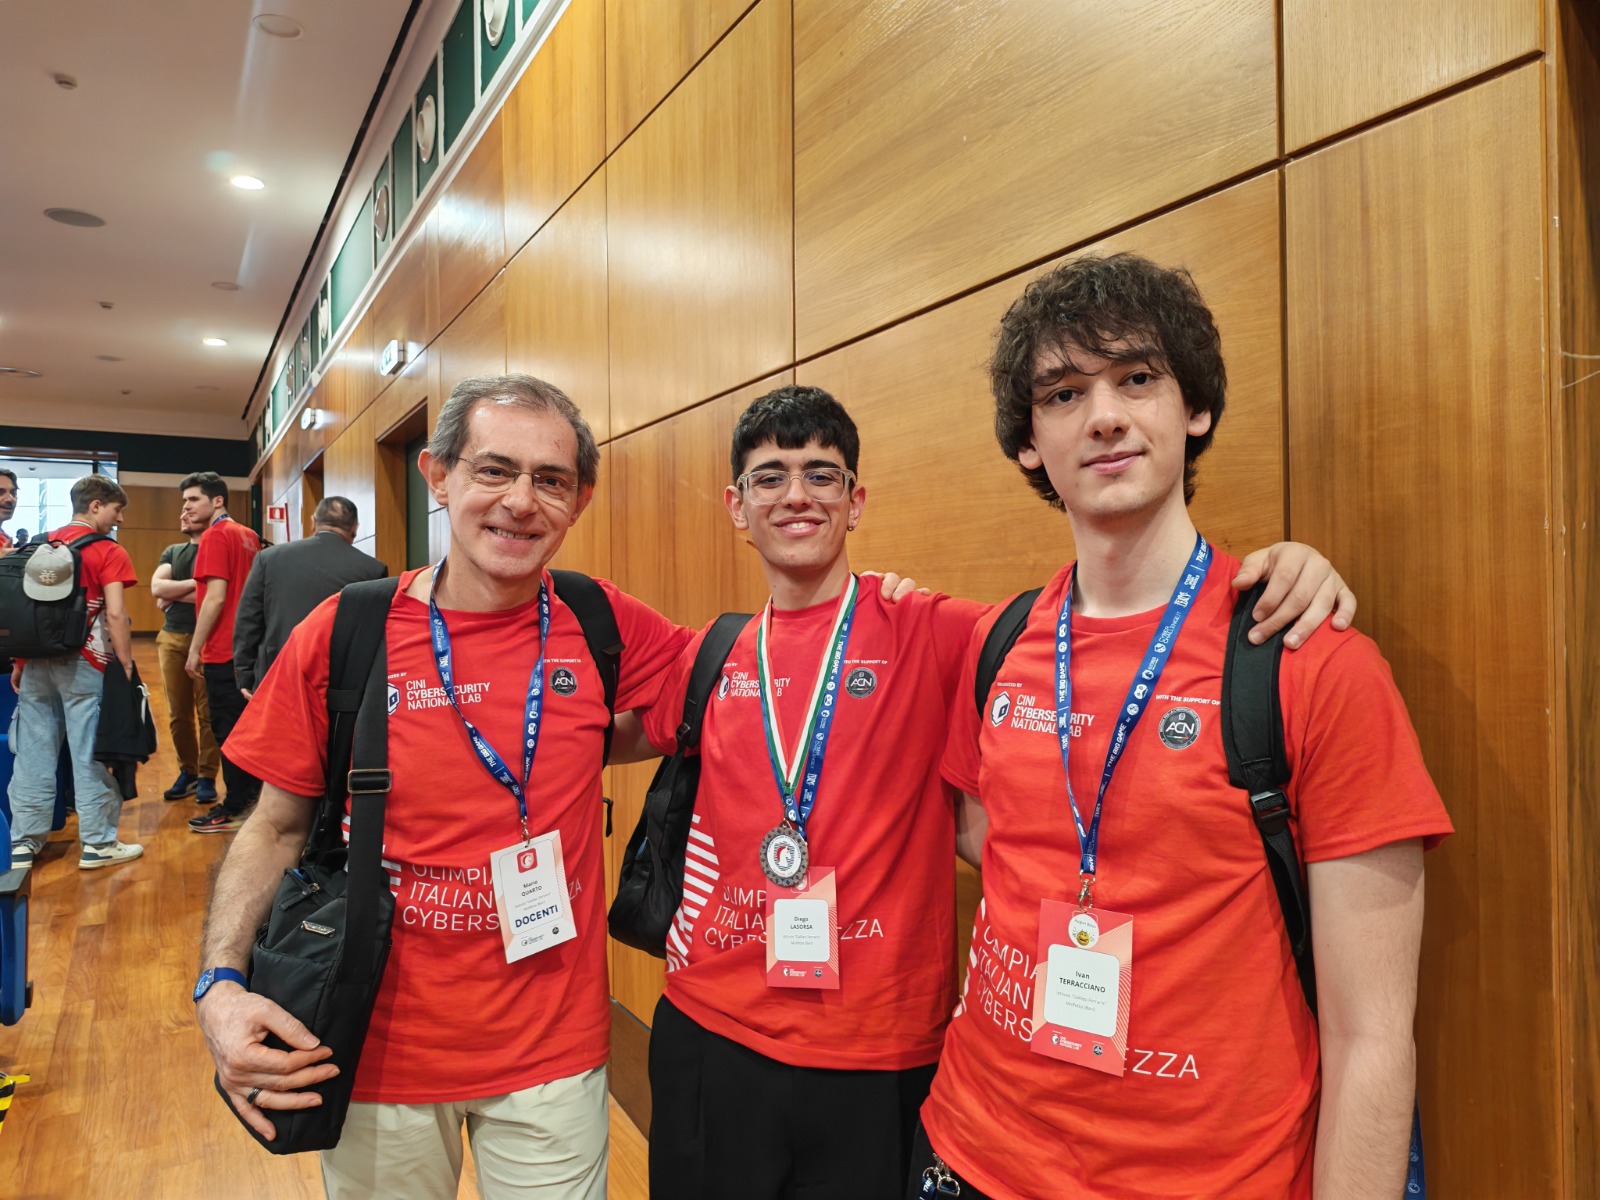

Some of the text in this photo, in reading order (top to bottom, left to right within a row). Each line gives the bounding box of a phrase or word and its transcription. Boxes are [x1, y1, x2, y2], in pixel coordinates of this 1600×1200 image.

[555, 677, 573, 686] ACN
[732, 671, 748, 680] CINI
[850, 678, 872, 686] ACN
[406, 679, 426, 691] CINI
[407, 682, 490, 701] CYBERSCURITY
[730, 688, 760, 697] NATIONA
[408, 693, 482, 710] NATIONA LAB
[1016, 694, 1036, 706] CINI
[1183, 697, 1211, 705] SUPPORT
[1010, 717, 1058, 735] NATIONAL
[1165, 721, 1195, 734] ACN
[1107, 754, 1116, 767] THE
[1112, 743, 1120, 755] BIG
[1116, 723, 1127, 743] GAME
[412, 864, 493, 886] OLIMPI
[410, 881, 493, 910] ITALIAN
[521, 885, 542, 897] QUARTO
[403, 905, 500, 931] CYBERS
[515, 904, 558, 928] DOCENTI
[714, 905, 765, 930] ITALIA
[1075, 971, 1090, 979] Ivan
[1059, 977, 1106, 993] TERRACCIANO
